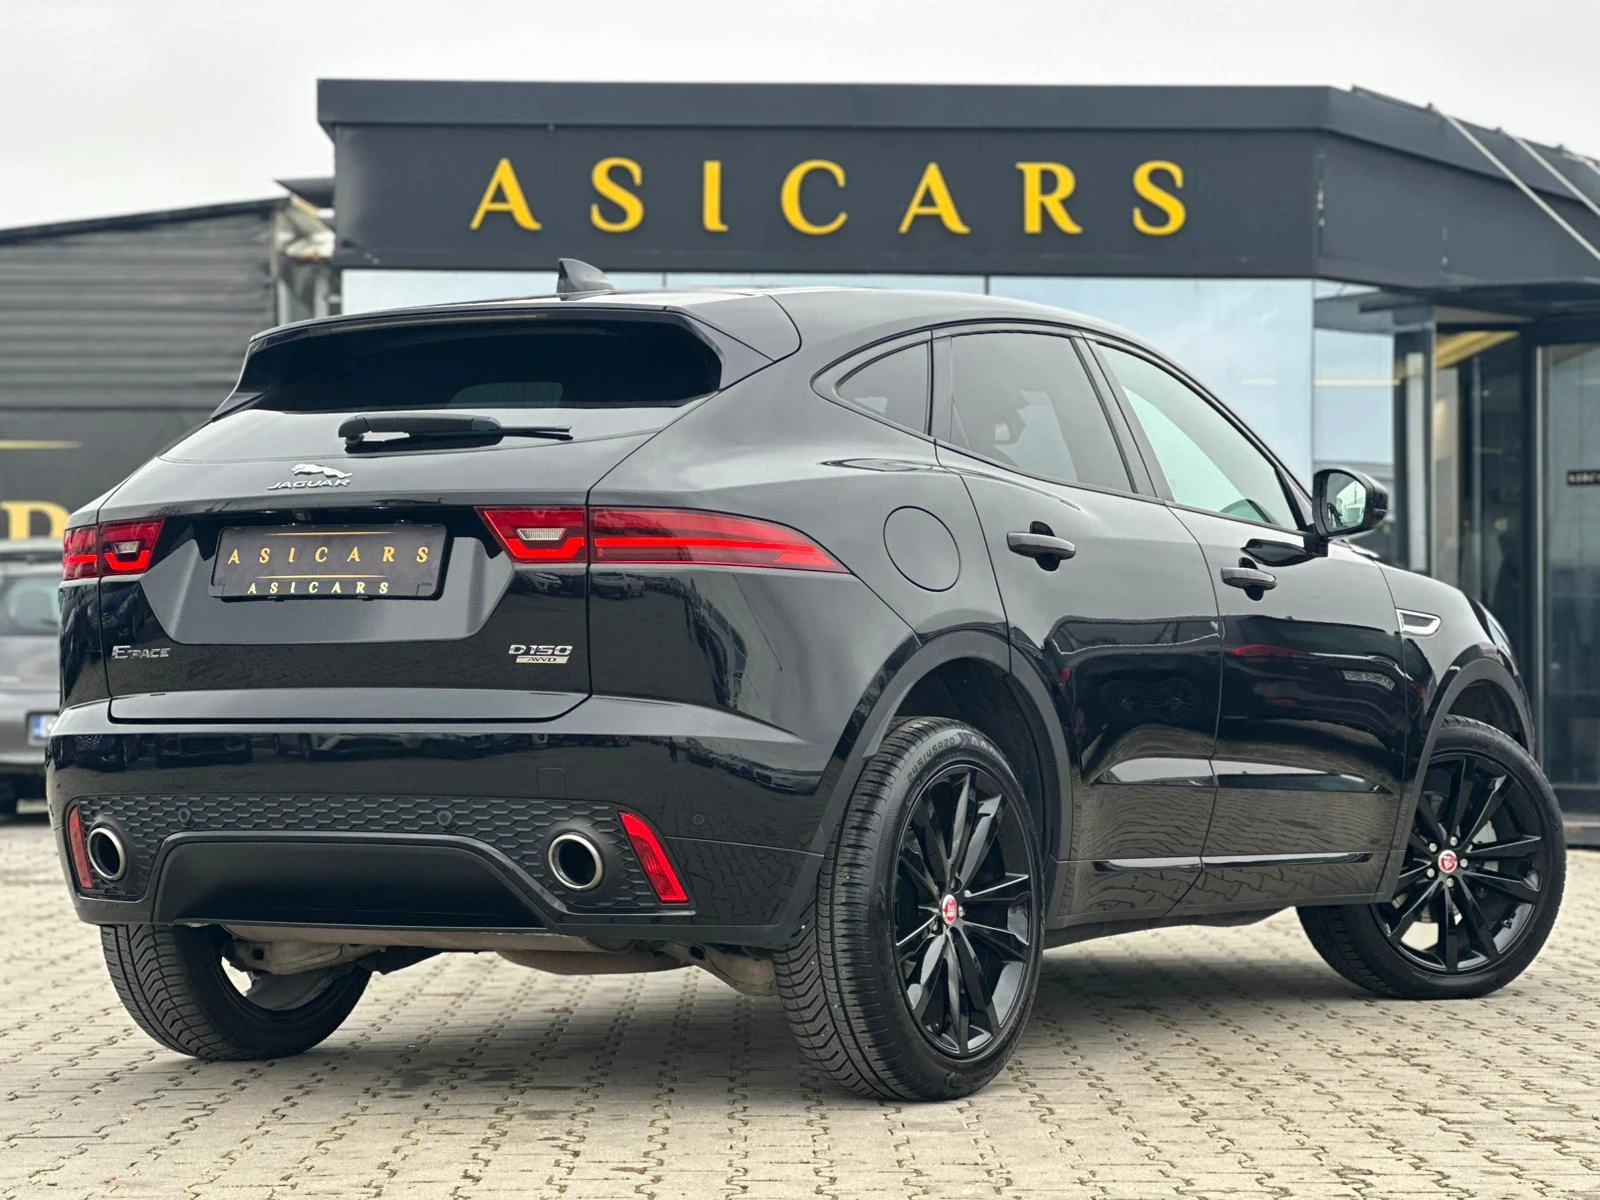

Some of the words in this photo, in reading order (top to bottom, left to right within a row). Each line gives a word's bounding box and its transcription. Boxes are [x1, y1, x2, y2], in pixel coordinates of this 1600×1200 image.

[470, 157, 1187, 236] ASICARS
[267, 479, 350, 490] JAGUAR
[227, 546, 429, 565] ASICARS
[247, 581, 389, 595] ASICARS
